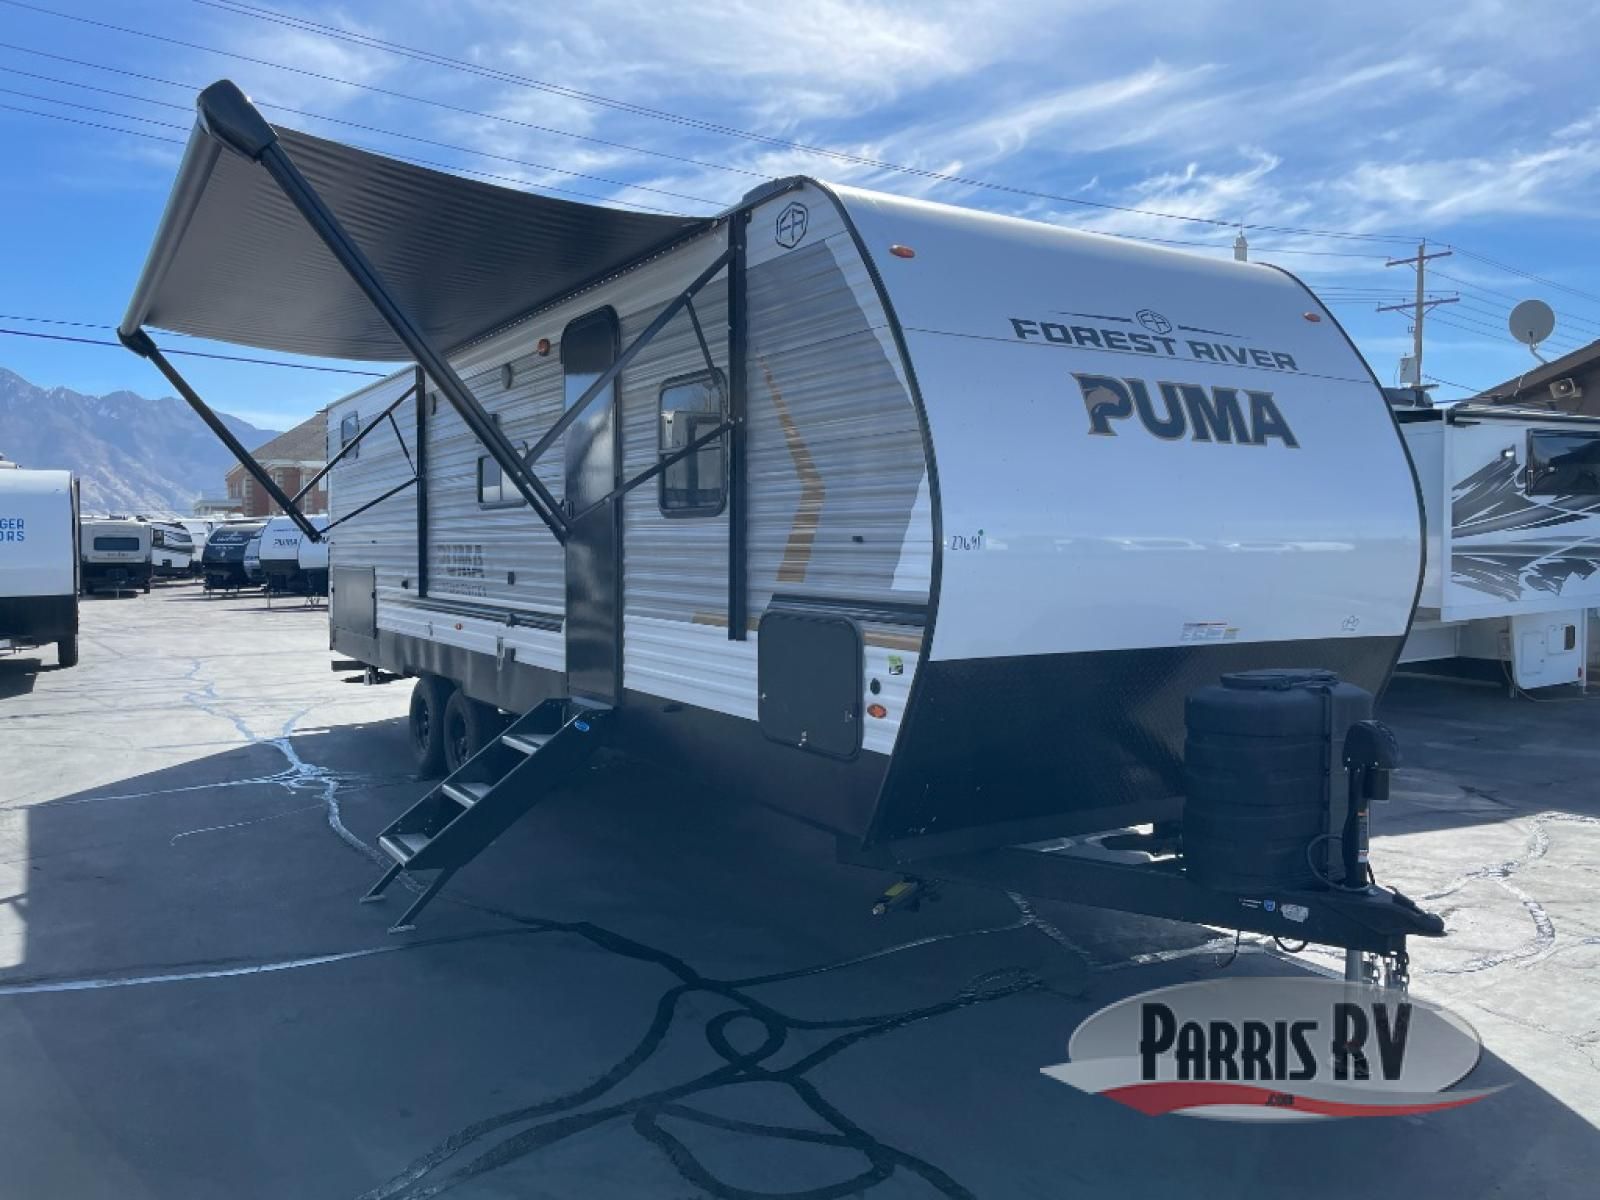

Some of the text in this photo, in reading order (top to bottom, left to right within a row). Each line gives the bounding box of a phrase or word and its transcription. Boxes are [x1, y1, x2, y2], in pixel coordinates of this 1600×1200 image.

[1009, 317, 1300, 371] FOREST RIVER
[1069, 371, 1301, 449] PUMA
